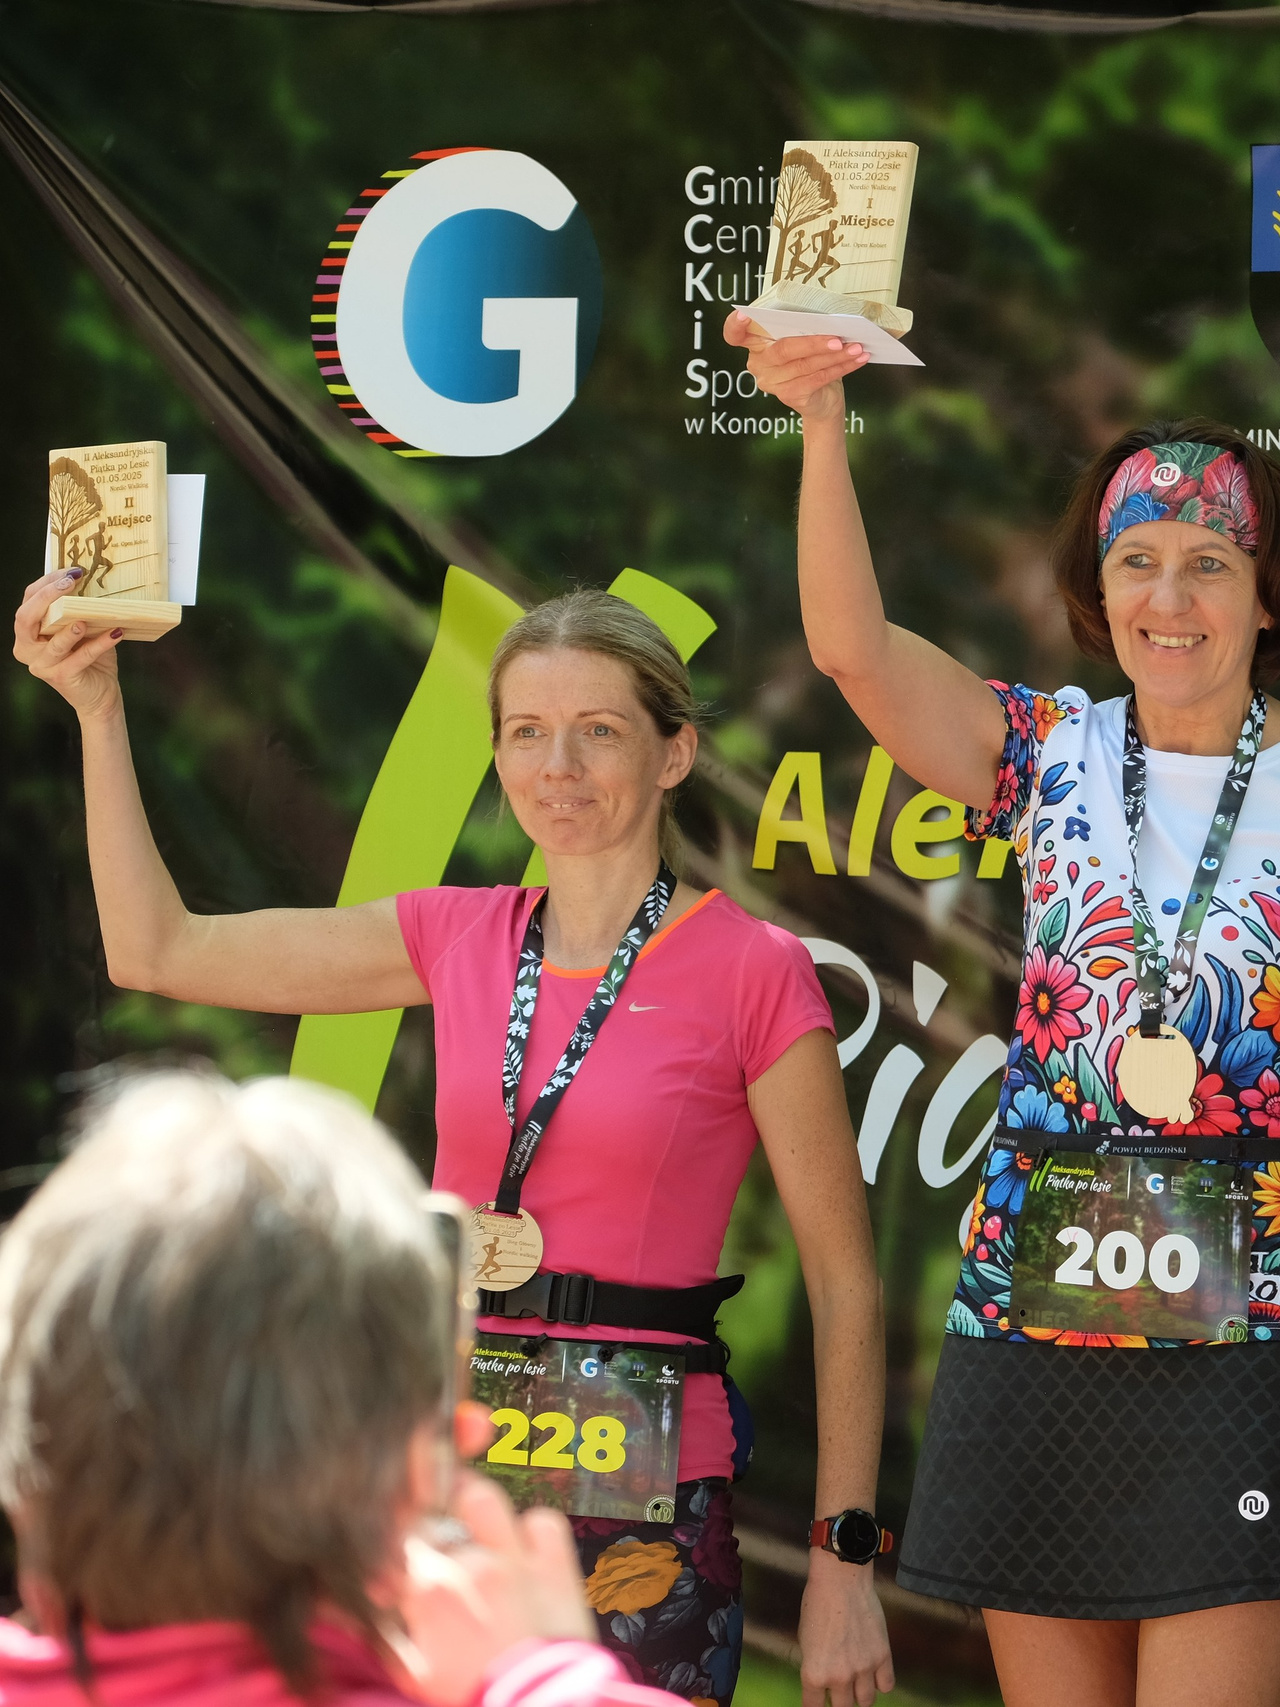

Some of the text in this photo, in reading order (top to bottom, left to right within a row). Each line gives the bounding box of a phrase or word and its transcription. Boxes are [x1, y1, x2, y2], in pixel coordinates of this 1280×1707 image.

[823, 149, 830, 157] II
[829, 161, 901, 171] Piątka po Lesie
[834, 172, 890, 181] 01.05.2025
[685, 166, 781, 205] Gmi
[866, 197, 874, 209] I
[840, 215, 895, 229] Miejsce
[685, 262, 766, 302] Kult
[336, 149, 579, 457] G
[694, 310, 703, 350] i
[685, 359, 770, 406] Spo
[685, 418, 704, 434] w
[84, 453, 90, 461] II
[90, 460, 149, 474] Piątka po Lesie
[96, 471, 142, 484] 01.05.2025
[125, 497, 134, 508] II
[107, 513, 152, 528] Miejsce
[1112, 1144, 1187, 1155] POWIAT BĘDZIŃSKI
[1051, 1165, 1096, 1177] Aleksandryjska
[1045, 1174, 1112, 1195] Piątka po lesie
[1146, 1173, 1165, 1194] G
[1054, 1226, 1200, 1294] 200
[474, 1347, 528, 1360] Aleksandryjsk
[469, 1356, 547, 1377] Piątka po lesie
[580, 1358, 598, 1378] G
[487, 1408, 626, 1473] 228
